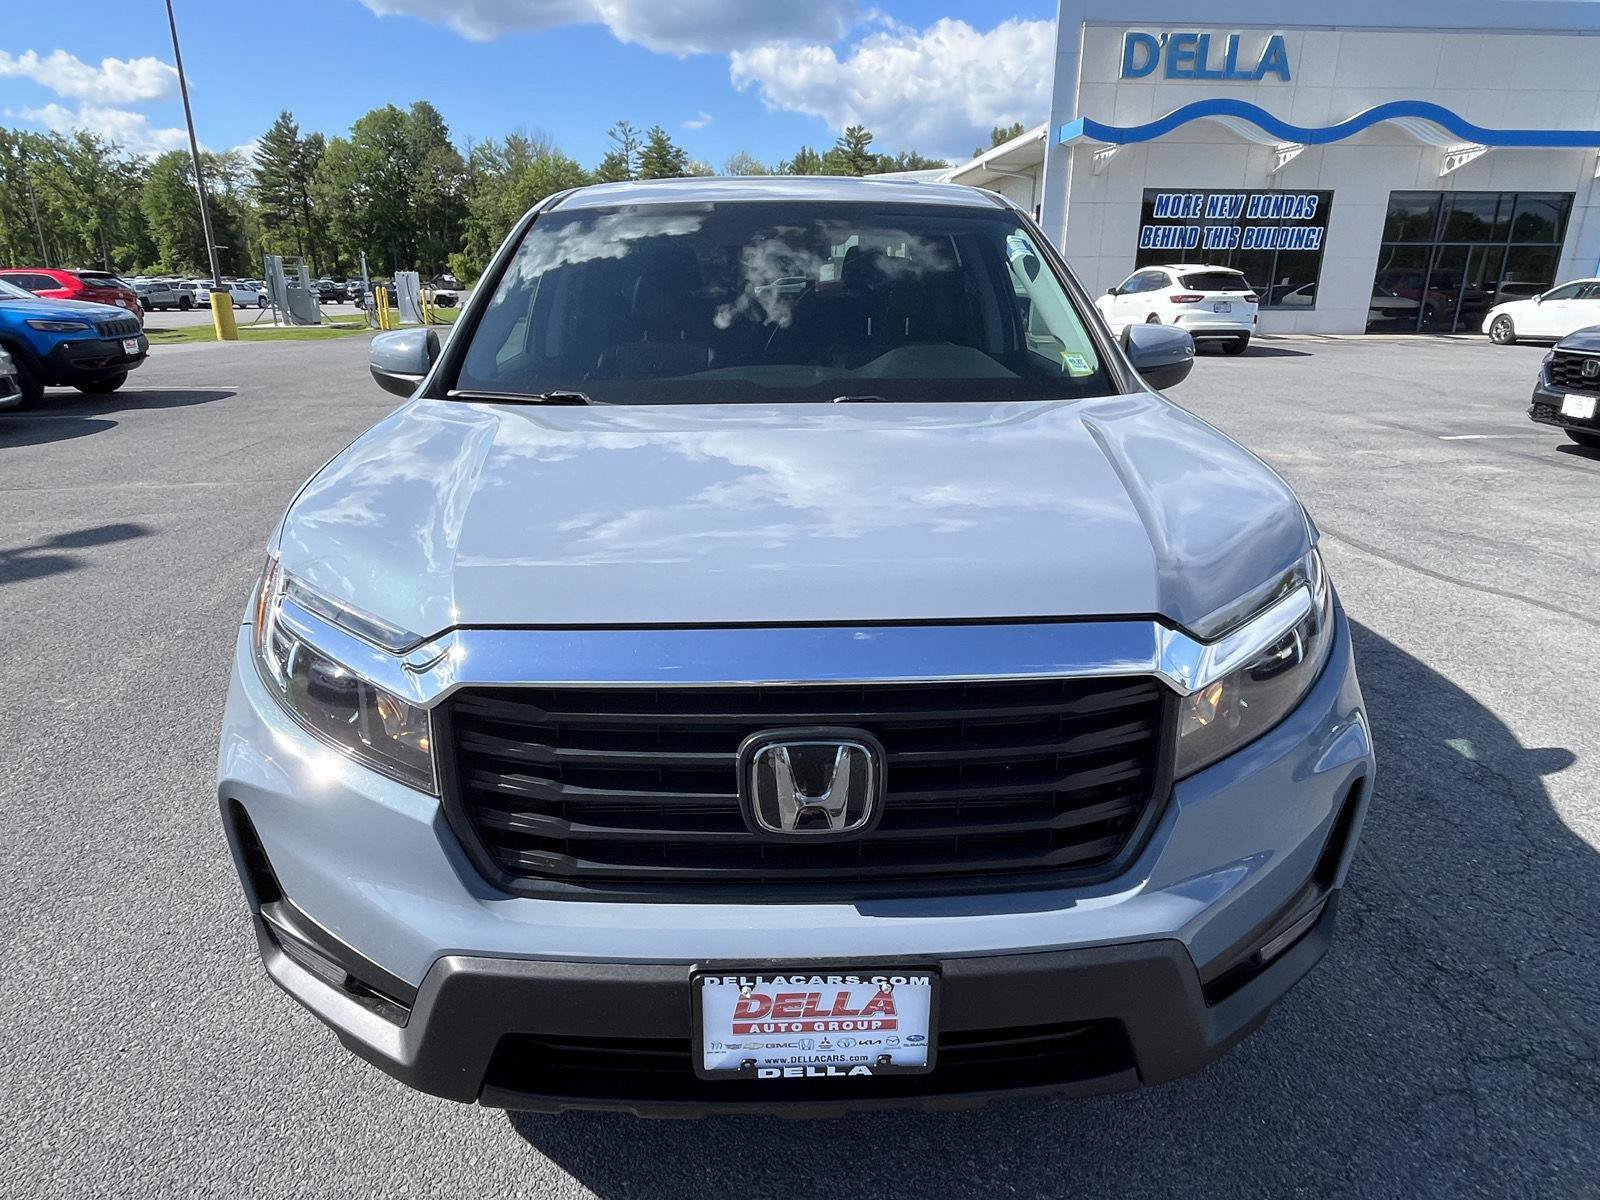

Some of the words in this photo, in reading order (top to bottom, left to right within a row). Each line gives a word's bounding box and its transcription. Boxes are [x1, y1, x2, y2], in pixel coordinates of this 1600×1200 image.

[1119, 31, 1291, 81] D'ELLA
[1153, 193, 1202, 218] MORE
[1205, 194, 1246, 218] NEW
[1246, 194, 1319, 219] HONDAS
[1139, 225, 1200, 249] BEHIND
[1202, 226, 1240, 249] THIS
[1241, 226, 1324, 250] BUILDING!
[704, 975, 930, 986] DELLACARS.COM
[733, 991, 898, 1020] DELLA
[750, 1022, 803, 1034] AUTO
[813, 1020, 882, 1031] GROUP
[757, 1065, 872, 1079] DELLA
